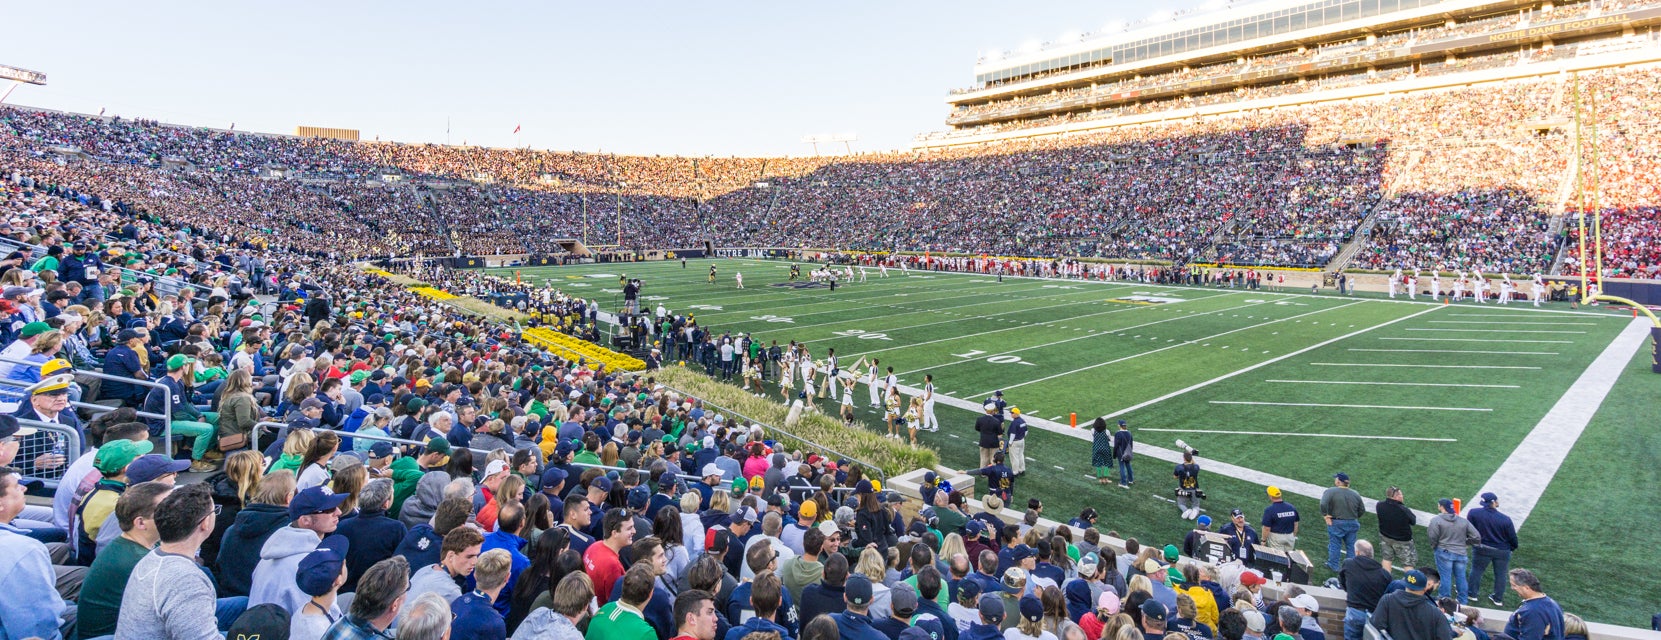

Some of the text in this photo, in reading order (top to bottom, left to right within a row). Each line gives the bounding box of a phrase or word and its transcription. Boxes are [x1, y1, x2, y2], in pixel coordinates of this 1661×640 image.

[1489, 14, 1630, 42] NOTRE DAME FOOTBALL
[716, 249, 743, 257] NOTRE
